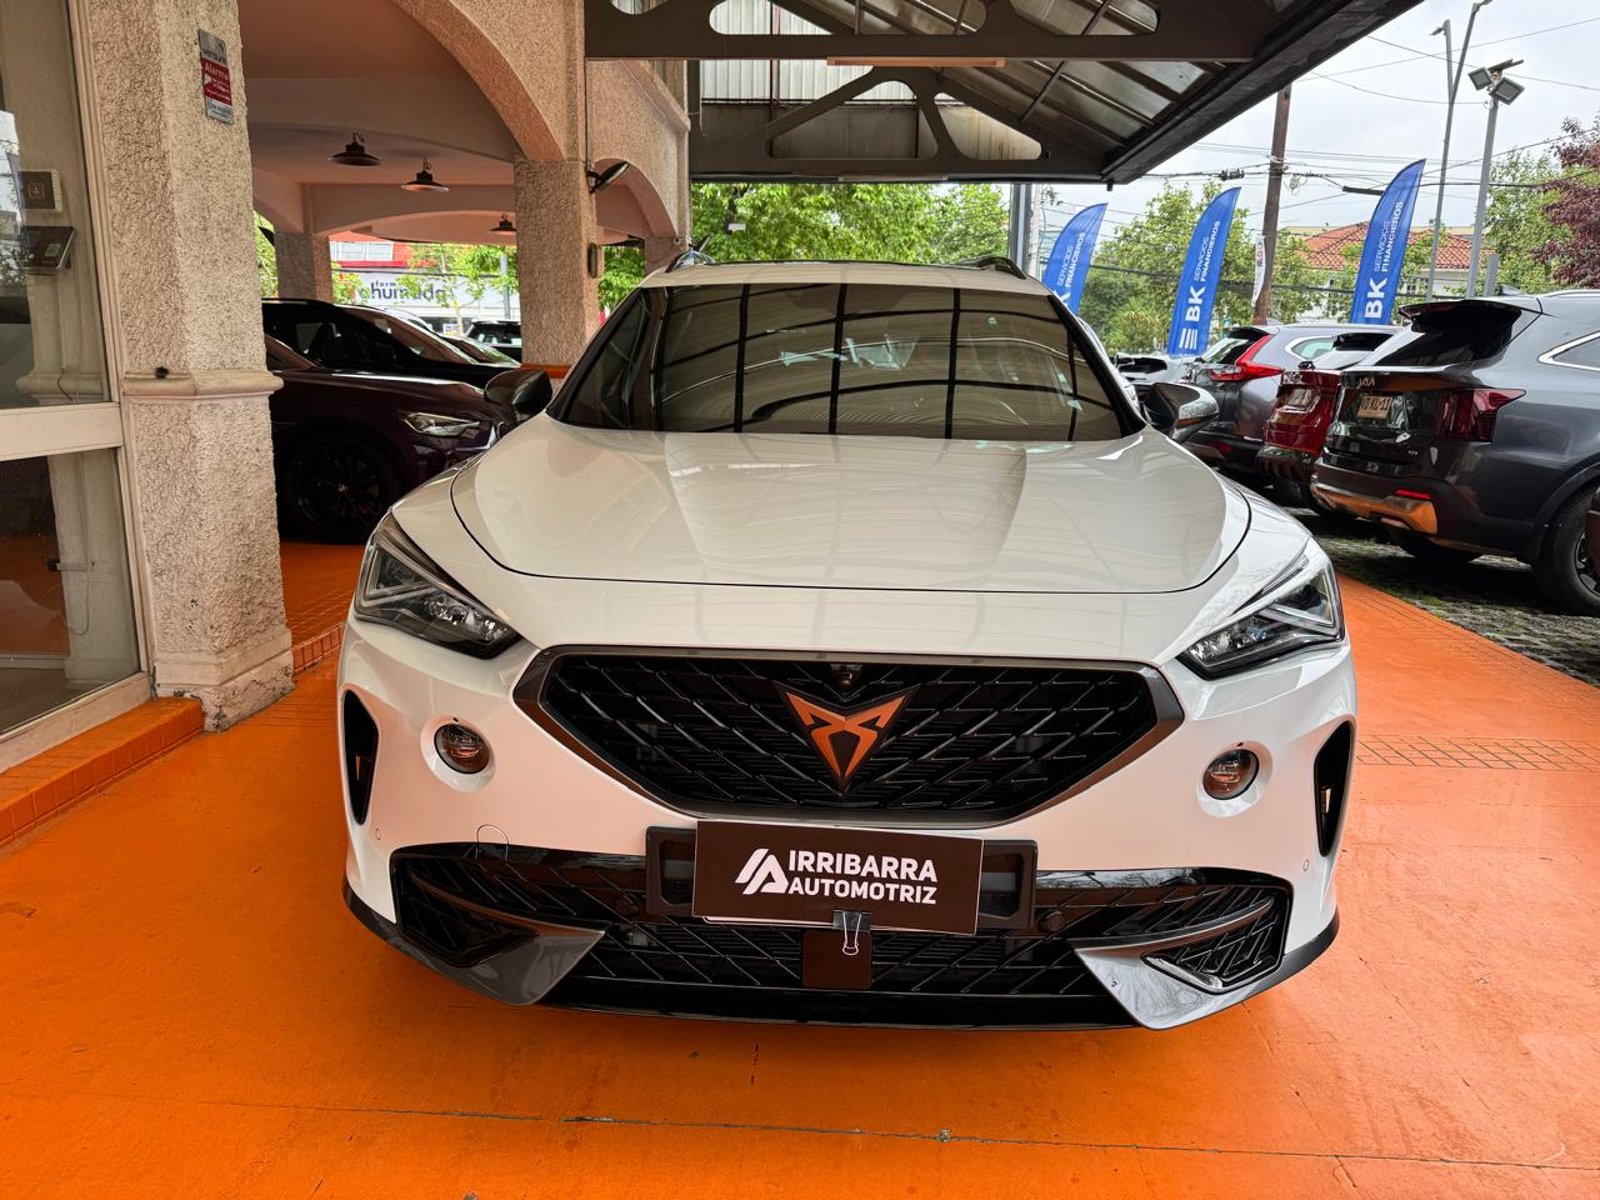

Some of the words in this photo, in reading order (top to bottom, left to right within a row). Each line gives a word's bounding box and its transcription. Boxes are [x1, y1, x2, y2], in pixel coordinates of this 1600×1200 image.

[1200, 220, 1221, 282] FINANCIEROS
[1374, 219, 1390, 272] SERVICIOS
[1382, 201, 1403, 272] FINANCIEROS
[1056, 245, 1073, 287] SERVICIOS
[1064, 231, 1086, 288] FINANCIEROS
[1193, 236, 1209, 281] SERVICIOS
[1184, 285, 1206, 322] BK
[1364, 278, 1388, 319] BK
[788, 850, 938, 882] IRRIBARRA
[788, 877, 938, 905] AUTOMOTRIZ
